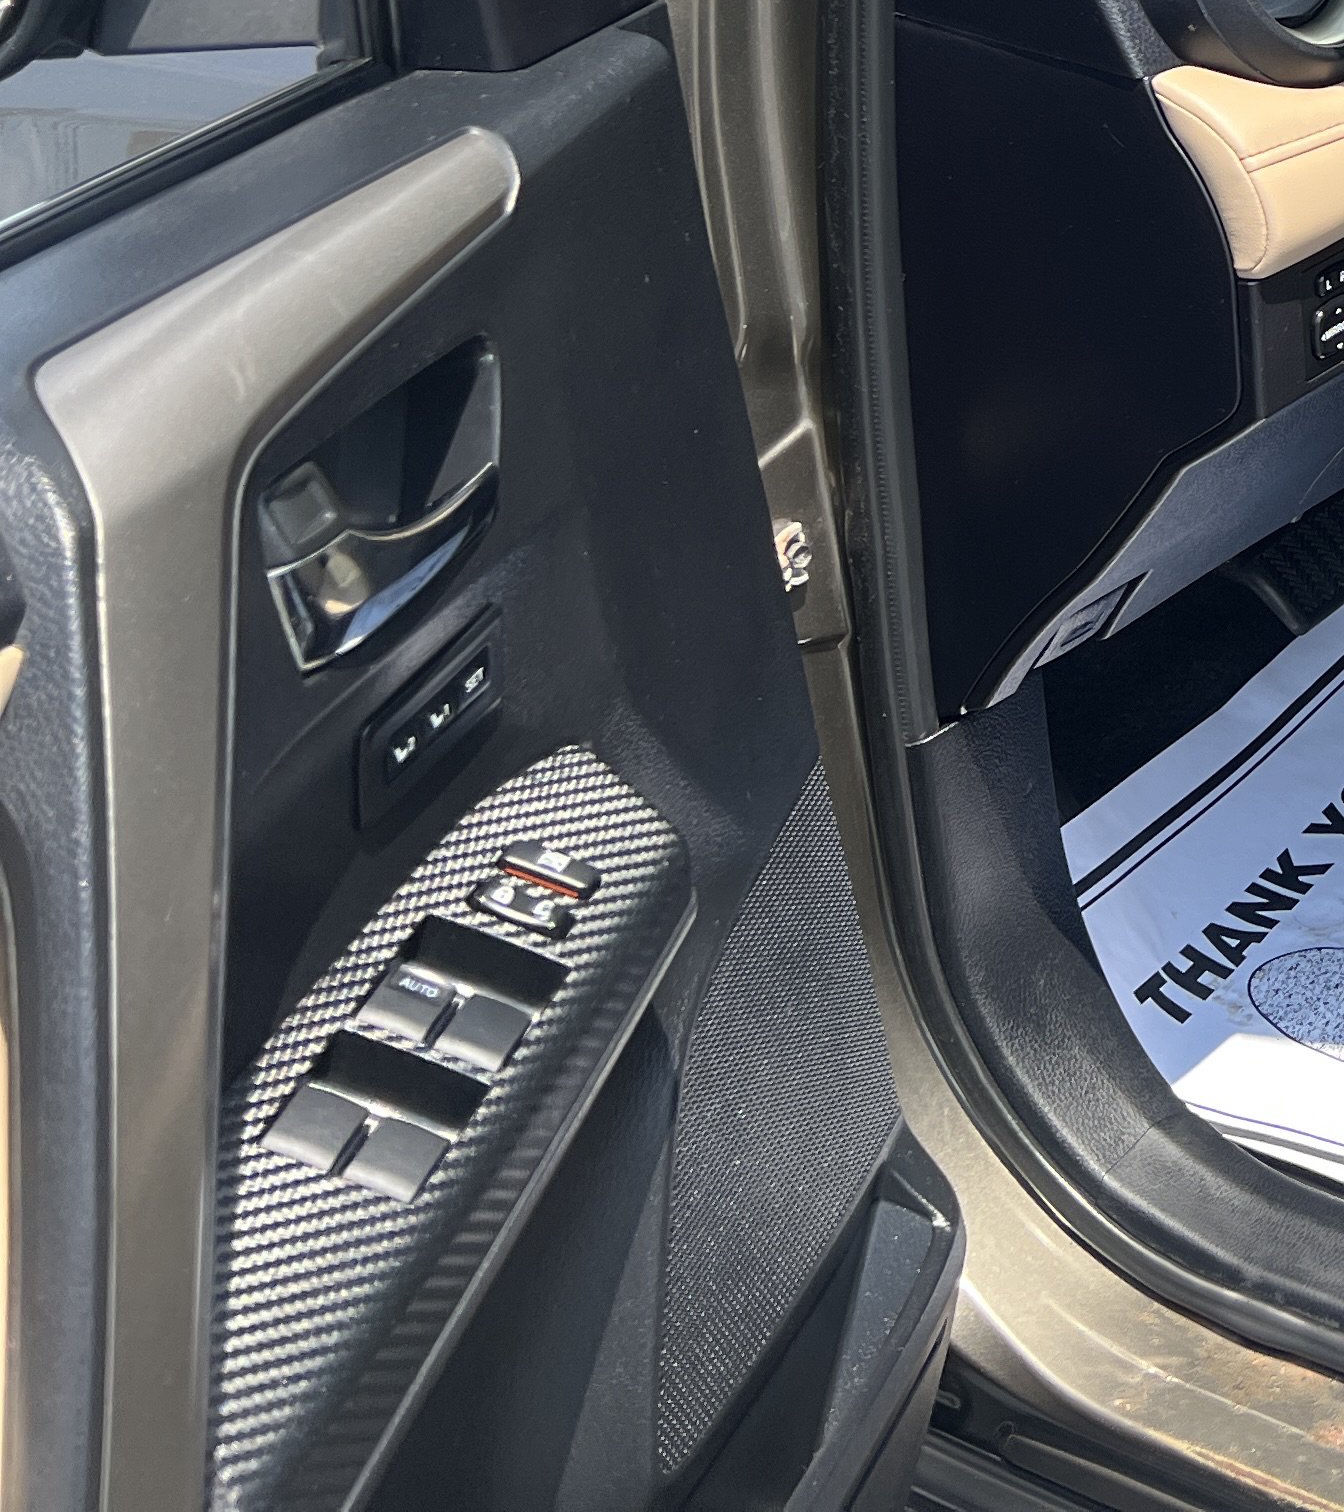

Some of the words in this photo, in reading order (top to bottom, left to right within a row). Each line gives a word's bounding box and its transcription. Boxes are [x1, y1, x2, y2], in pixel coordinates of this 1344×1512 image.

[1325, 279, 1333, 291] L
[1133, 848, 1335, 1024] THANK
[398, 976, 440, 998] AUTO
